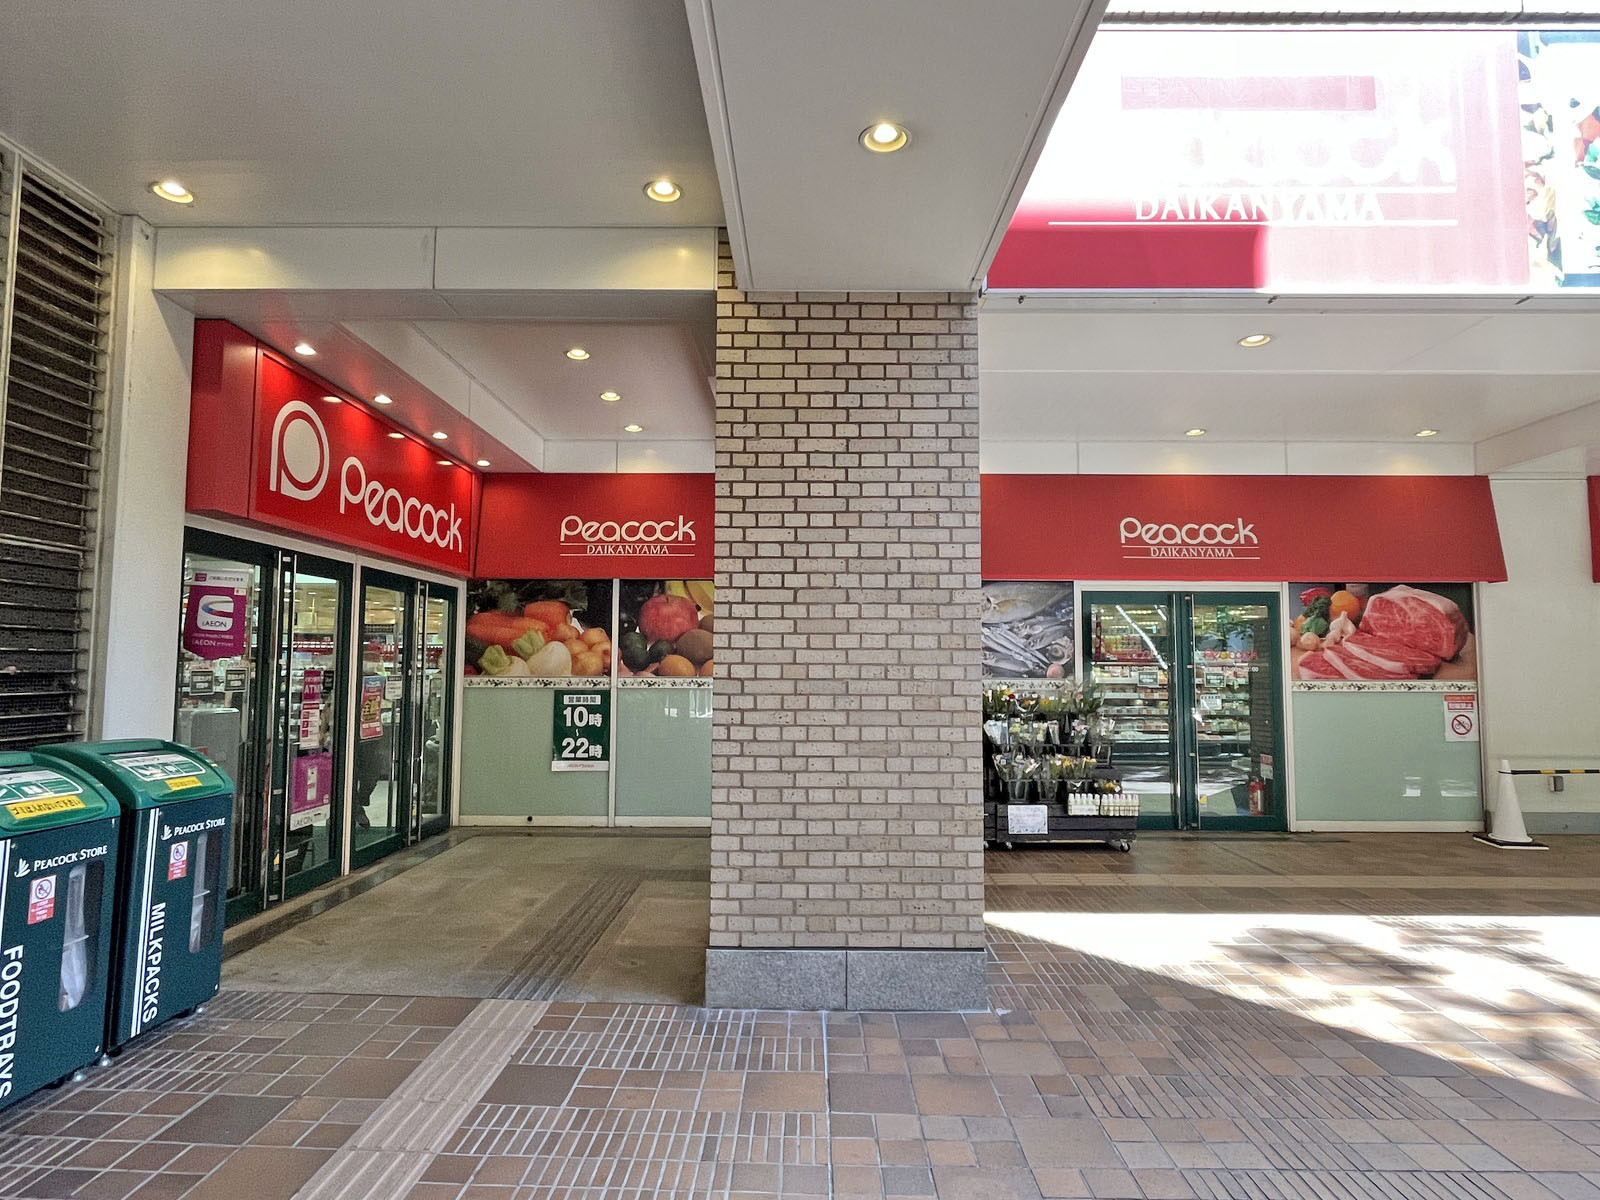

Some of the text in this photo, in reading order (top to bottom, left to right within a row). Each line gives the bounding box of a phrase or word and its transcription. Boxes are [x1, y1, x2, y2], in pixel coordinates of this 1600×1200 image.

[1134, 190, 1385, 222] DAIKANYAMA
[339, 456, 463, 553] Peacock
[559, 514, 697, 542] Peacock
[1119, 516, 1259, 545] Peacock
[585, 544, 671, 555] DAIKANYAMA
[1150, 547, 1235, 558] DAIKANYAMA
[563, 706, 603, 728] 10時
[561, 737, 603, 759] 22時
[174, 817, 226, 837] PEACOCK STORE
[33, 845, 108, 872] PEACOCK STORE
[142, 902, 167, 1024] MILKPACKS
[0, 944, 24, 1099] FOODTRAYS
